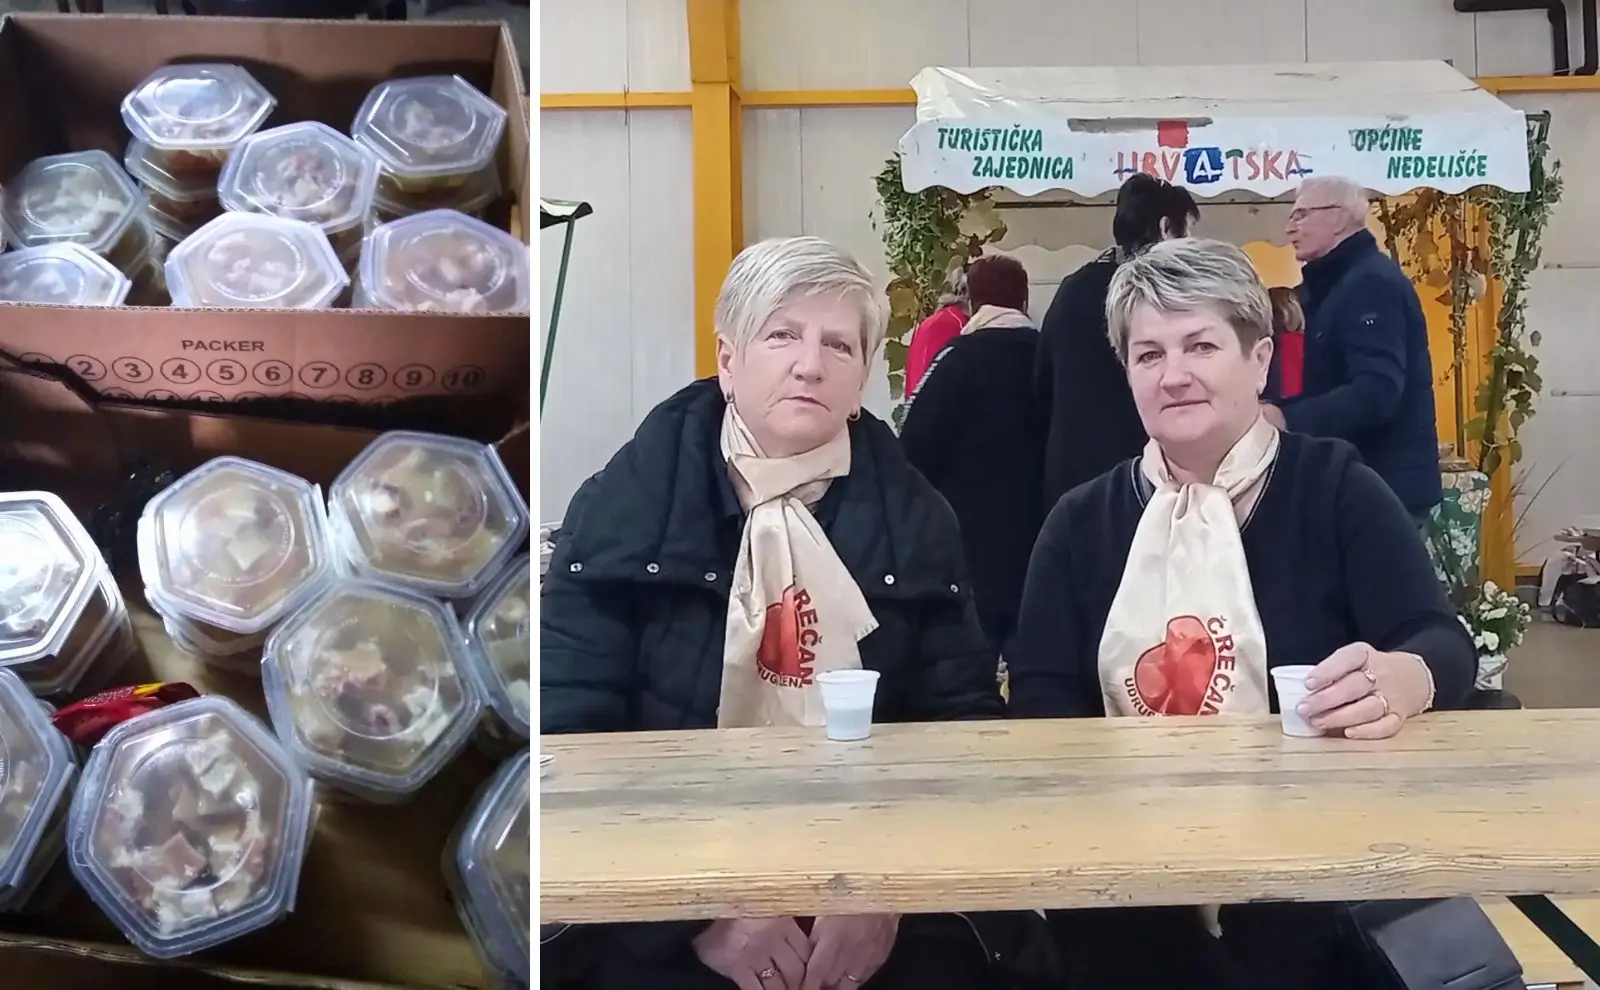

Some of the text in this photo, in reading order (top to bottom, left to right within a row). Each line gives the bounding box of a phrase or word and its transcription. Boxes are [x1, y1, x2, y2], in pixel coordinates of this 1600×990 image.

[938, 124, 1043, 152] TURISTIČKA
[1354, 124, 1423, 151] OPĆINE
[971, 156, 1073, 179] ZAJEDNICA
[1114, 147, 1314, 184] HRVATSKA
[1387, 149, 1487, 179] NEDELIŠĆE
[181, 339, 265, 352] PACKER
[77, 360, 481, 387] 2 3 4 5 6 7 8 9 10
[793, 587, 824, 685] REČAN
